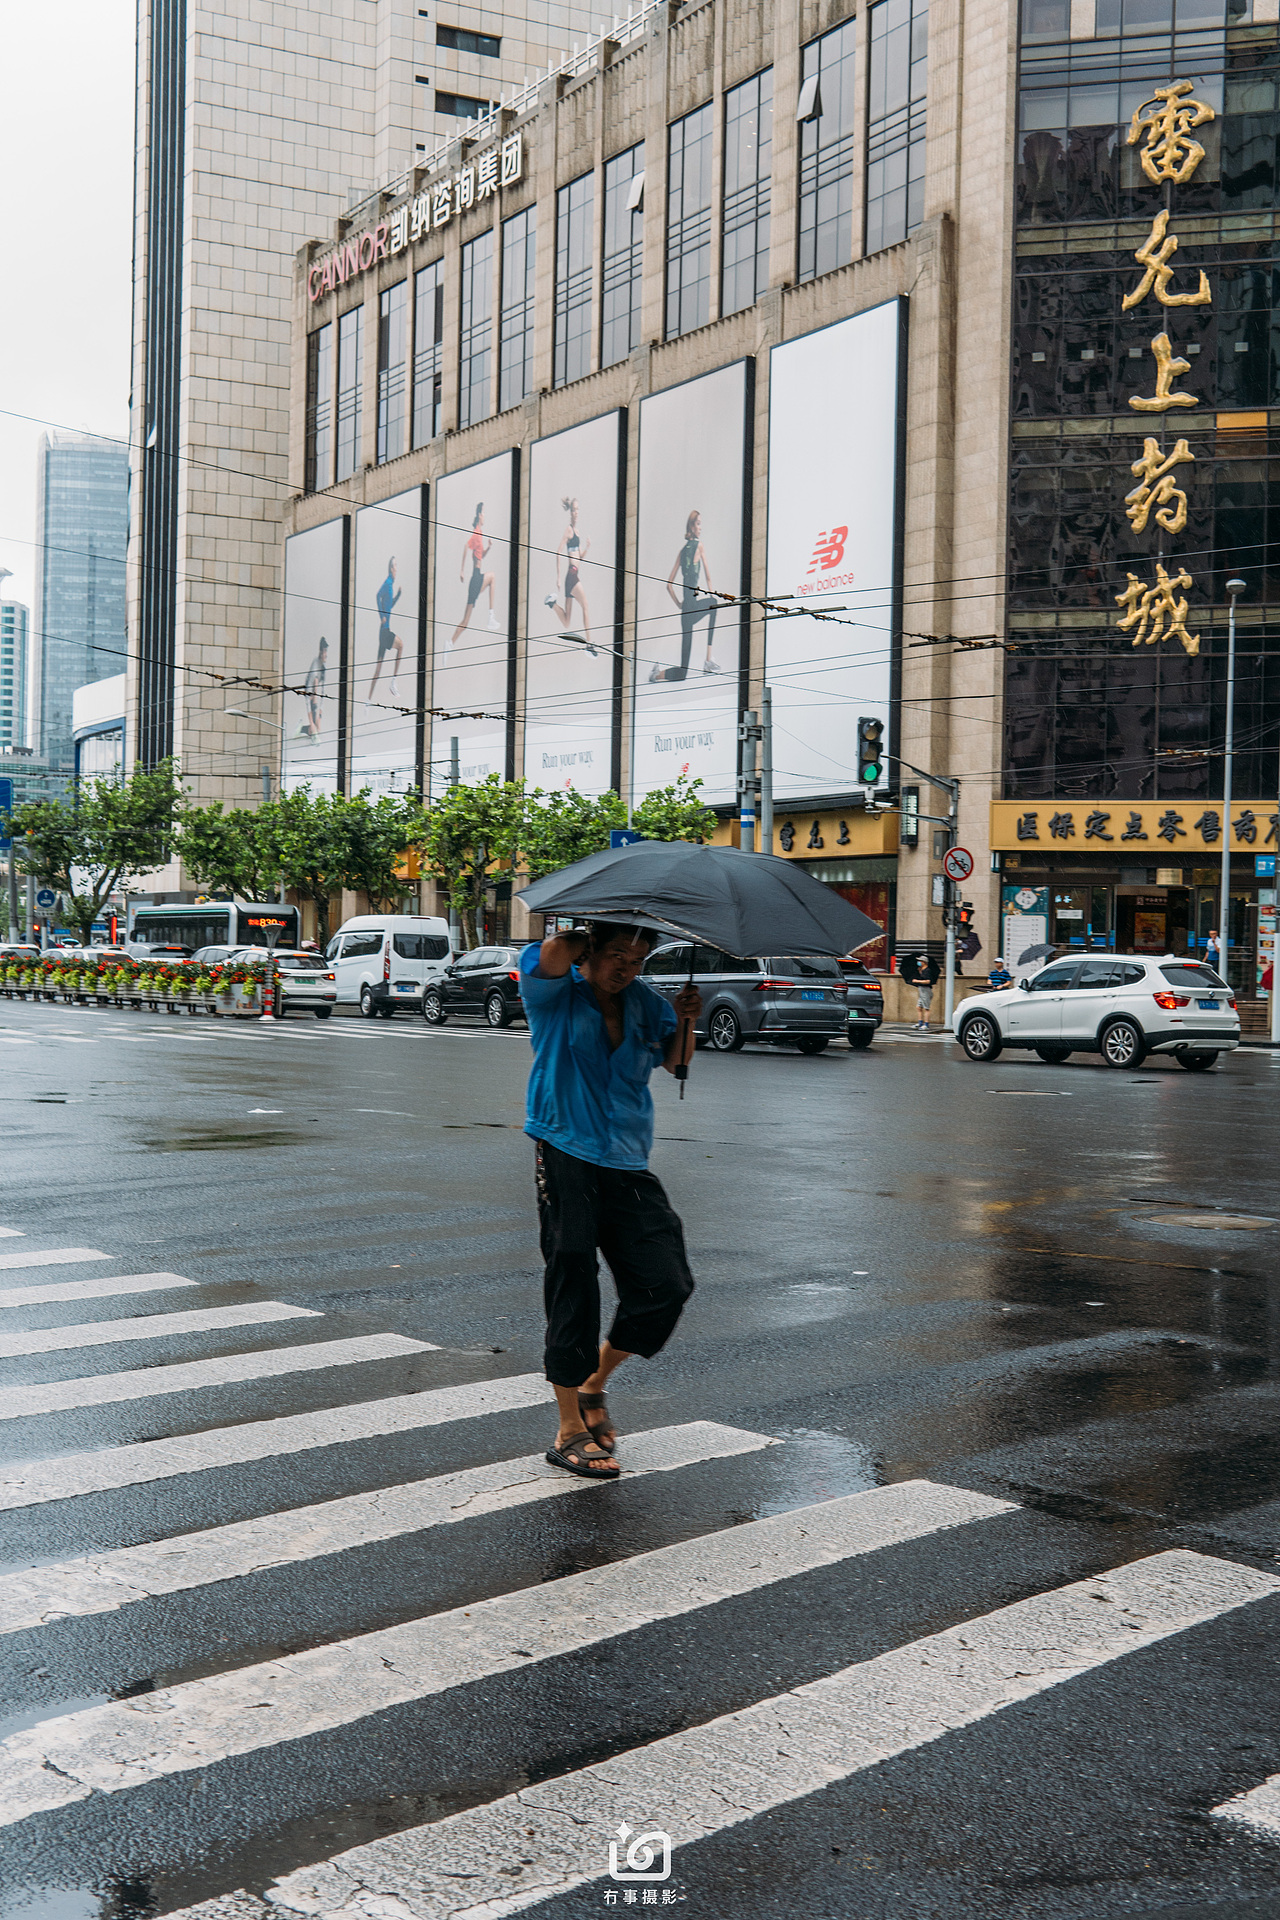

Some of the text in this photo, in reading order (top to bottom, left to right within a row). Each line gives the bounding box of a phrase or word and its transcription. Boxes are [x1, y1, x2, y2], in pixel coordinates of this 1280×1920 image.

[308, 132, 522, 301] CANNOR 凯纳咨询集团
[797, 572, 854, 595] new balance
[654, 735, 672, 752] Run
[674, 735, 696, 756] your
[542, 752, 558, 768] Run
[559, 753, 577, 771] your
